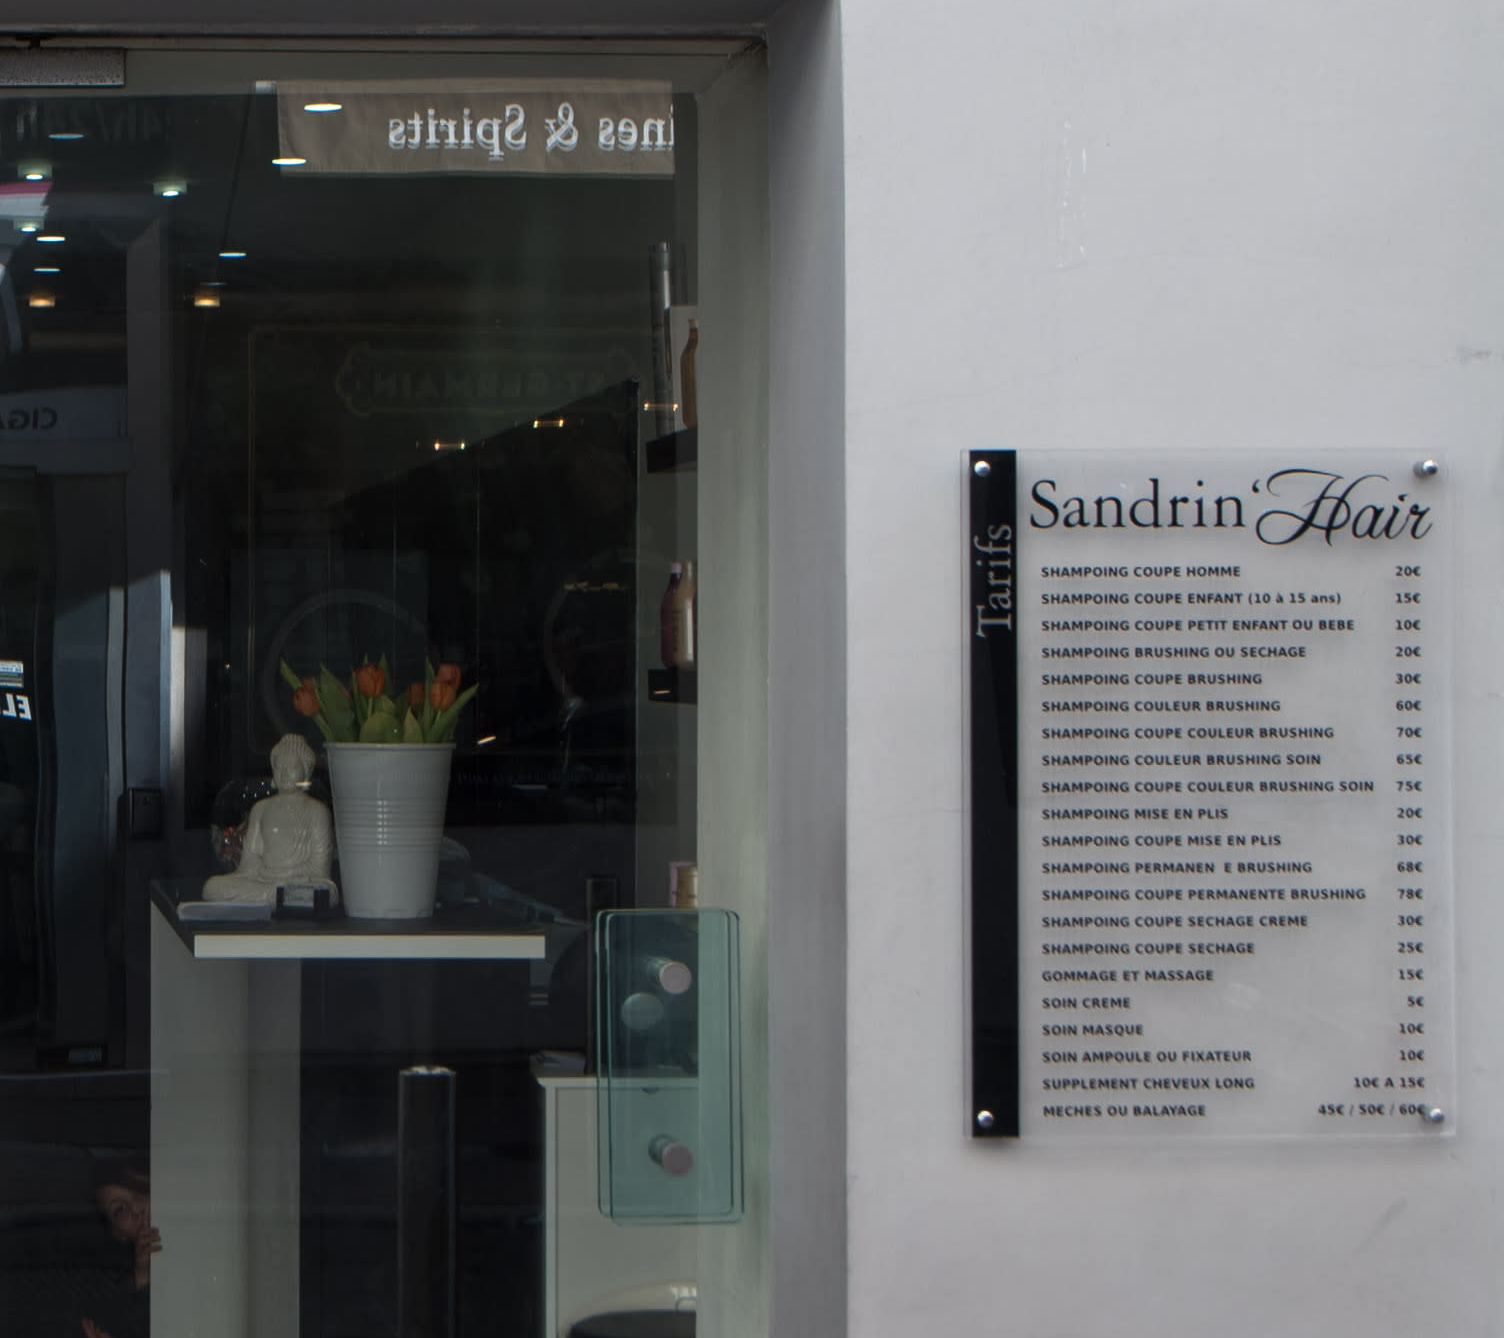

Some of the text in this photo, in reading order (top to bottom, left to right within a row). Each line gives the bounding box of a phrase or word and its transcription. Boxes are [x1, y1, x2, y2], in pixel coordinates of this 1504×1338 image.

[1254, 467, 1433, 547] Hair
[1040, 565, 1241, 579] SHAMPOING COUPE HOMME
[1395, 565, 1422, 578] 20€
[974, 522, 1013, 640] Tarifs
[1040, 592, 1130, 605] SHAMPOING
[1133, 592, 1183, 605] COUPE
[1187, 592, 1244, 605] ENFANT
[1288, 591, 1307, 604] 15
[1395, 591, 1422, 605] 15€
[1041, 618, 1355, 632] SHAMPOING COUPE PETIT ENFANT OU BEBE
[1395, 618, 1422, 632] 10€
[1041, 645, 1307, 659] SHAMPOING BRUSHING OU SECHAGE
[1395, 645, 1422, 658] 20€
[1041, 672, 1263, 686] SHAMPOING COUPE BRUSHING
[1394, 672, 1422, 685] 30€
[1041, 700, 1281, 713] SHAMPOING COULEUR BRUSHING
[1395, 699, 1422, 712] 60€
[1041, 726, 1335, 740] SHAMPOING COUPE COULEUR BRUSHING
[1395, 726, 1423, 739] 70€
[1041, 753, 1322, 767] SHAMPOING COULEUR BRUSHING SOIN
[1395, 753, 1423, 766] 65€
[1041, 780, 1375, 794] SHAMPOING COUPE COULEUR BRUSHING SOIN
[1395, 780, 1423, 793] 75€
[1041, 807, 1229, 821] SHAMPOING MISE EN PLIS
[1396, 806, 1423, 820] 20€
[1041, 834, 1282, 848] SHAMPOING COUPE MISE EN PLIS
[1396, 833, 1424, 846] 30€
[1041, 861, 1313, 875] SHAMPOING PERMANENE BRUSHING
[1396, 860, 1424, 874] 68€
[1041, 888, 1367, 902] SHAMPOING COUPE PERMANENTE BRUSHING
[1396, 887, 1424, 900] 78€
[1041, 914, 1308, 929] SHAMPOING COUPE SECHAGE CREME
[1397, 914, 1424, 928] 30€
[1041, 942, 1255, 956] SHAMPOING COUPE SECHAGE
[1397, 941, 1425, 955] 25€
[1041, 969, 1214, 983] GOMMAGE ET MASSAGE
[1398, 968, 1425, 981] 15€
[1041, 996, 1131, 1010] SOIN CREME
[1406, 995, 1425, 1008] 5€
[1042, 1023, 1144, 1038] SOIN MASQUE
[1399, 1022, 1425, 1035] 10€
[1042, 1050, 1252, 1064] SOIN AMPOULE OU FIXATEUR
[1399, 1049, 1425, 1062] 10€
[1042, 1076, 1256, 1091] SUPPLEMENT CHEVEUX LONG
[1353, 1076, 1426, 1089] 10€ A 15€
[1042, 1104, 1206, 1118] MECHES OU BALAYAGE
[1317, 1103, 1345, 1117] 45€
[1358, 1103, 1385, 1116] 50€
